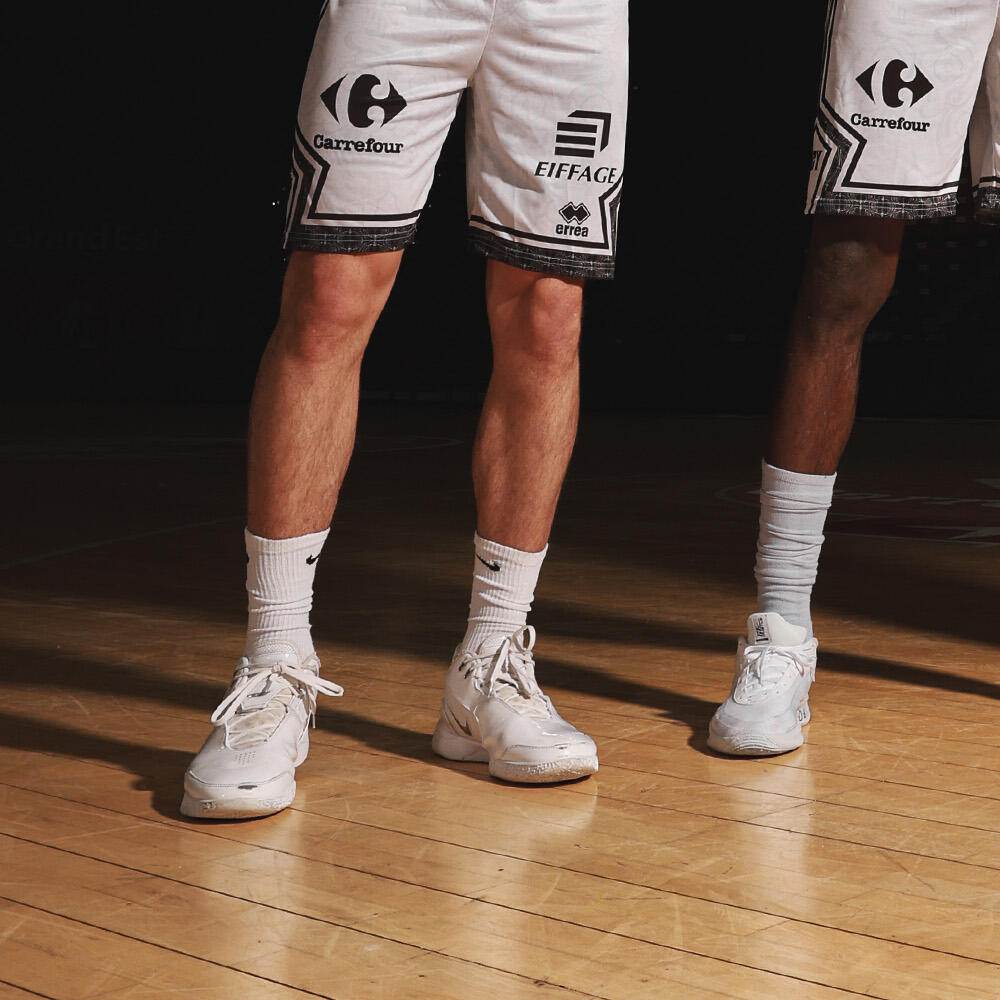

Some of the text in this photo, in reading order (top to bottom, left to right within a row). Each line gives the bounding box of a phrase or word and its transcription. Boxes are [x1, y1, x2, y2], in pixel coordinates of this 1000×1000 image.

[850, 113, 931, 132] Carrefour
[313, 134, 404, 153] Carrefour
[534, 161, 618, 184] EIFFAGE
[555, 223, 589, 238] errea
